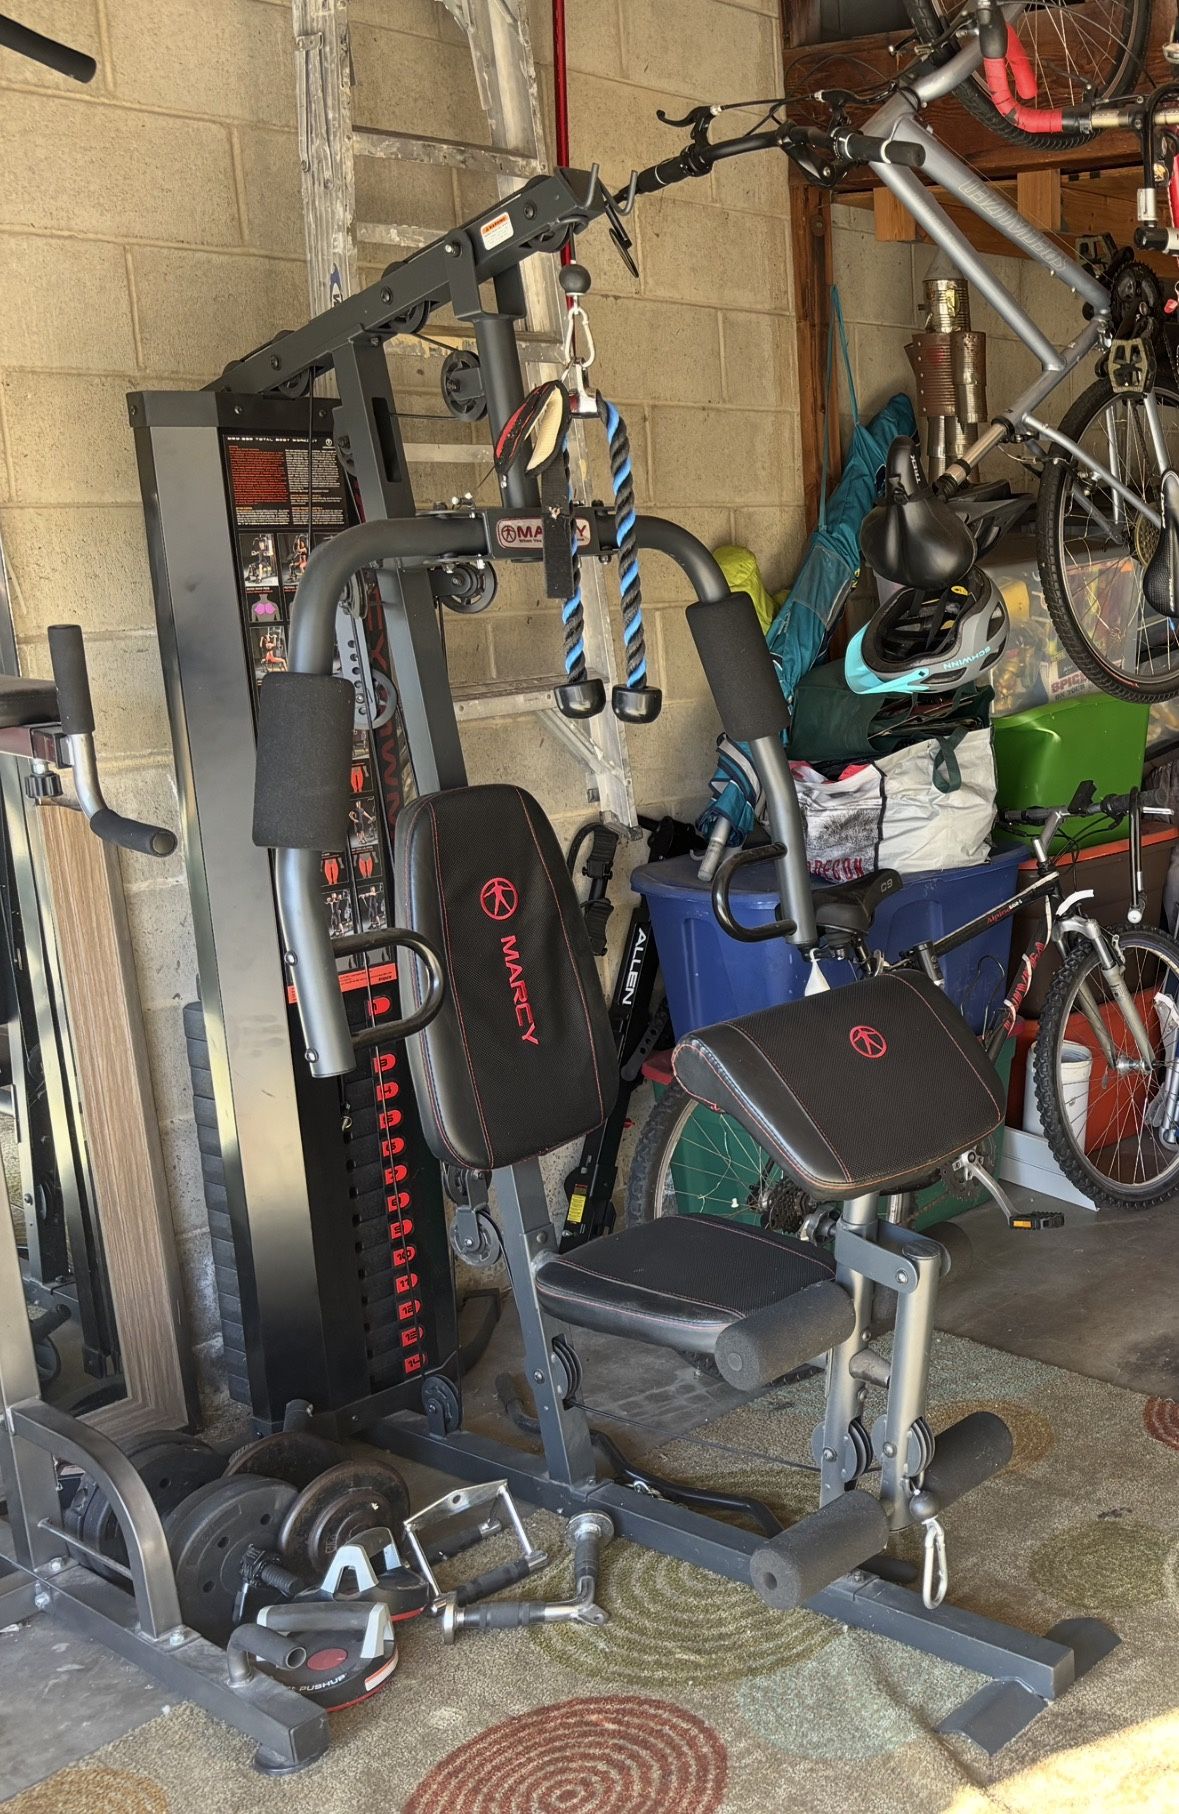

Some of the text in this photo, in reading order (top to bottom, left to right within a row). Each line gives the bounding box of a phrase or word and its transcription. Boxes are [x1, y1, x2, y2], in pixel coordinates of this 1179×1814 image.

[910, 455, 921, 484] TREK
[517, 525, 587, 539] MAY
[943, 646, 991, 670] SCHWINN
[622, 927, 647, 1005] ALLEN
[501, 935, 539, 1045] MARCY
[299, 1673, 346, 1692] PUSHUP
